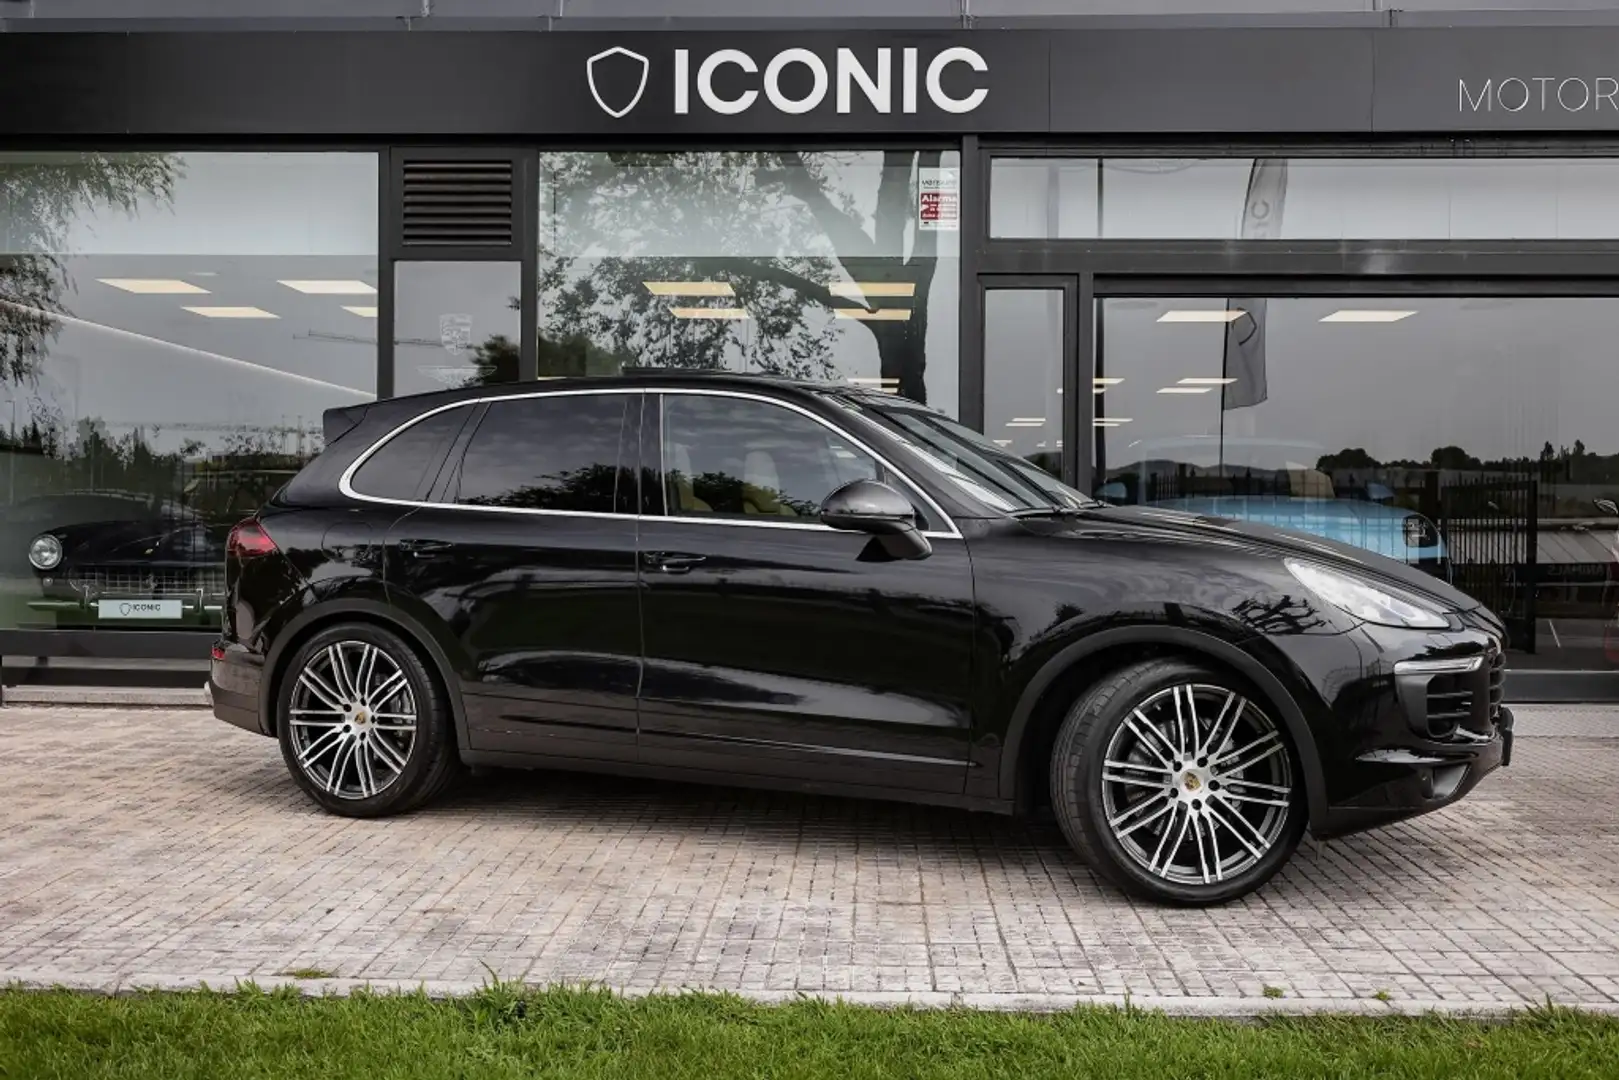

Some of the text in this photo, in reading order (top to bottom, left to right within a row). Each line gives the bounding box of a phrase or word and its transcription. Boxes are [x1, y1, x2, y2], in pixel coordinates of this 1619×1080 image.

[674, 47, 989, 115] ICONIC
[1458, 77, 1619, 112] MOTOR
[133, 604, 161, 612] ICONIC
